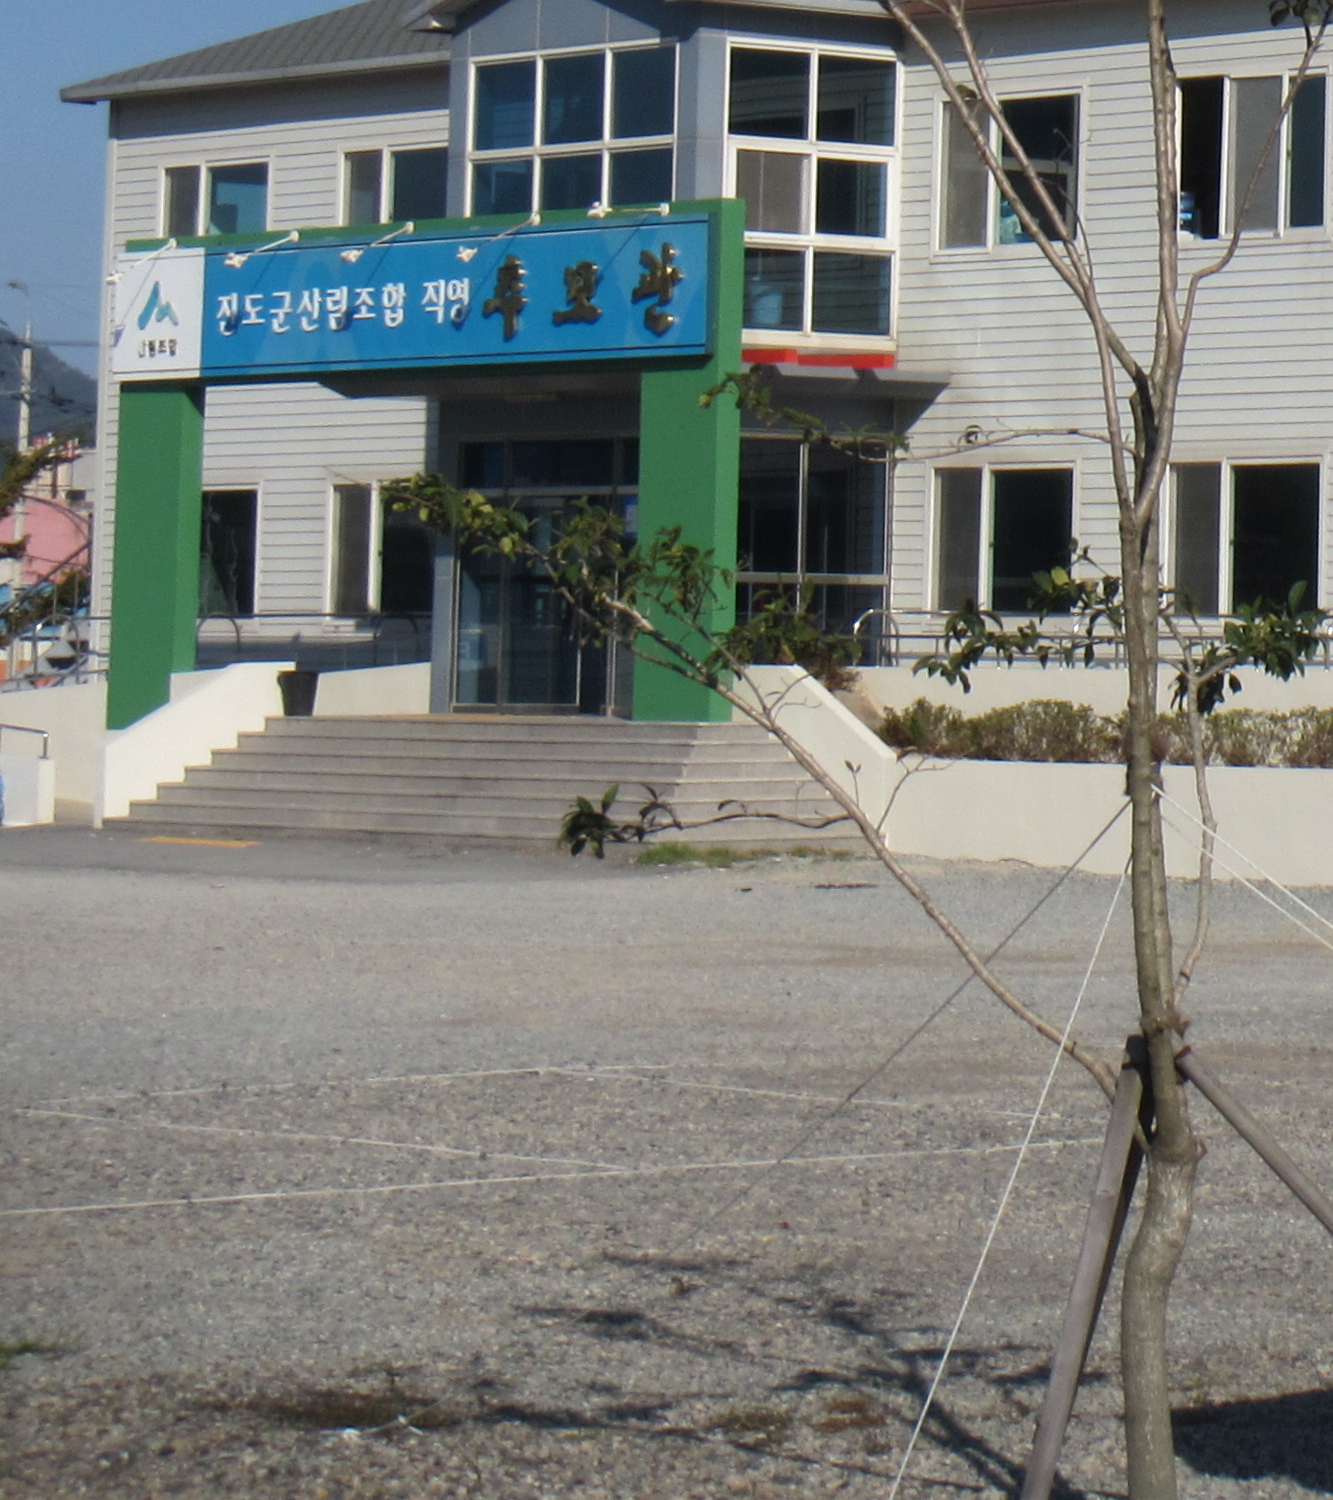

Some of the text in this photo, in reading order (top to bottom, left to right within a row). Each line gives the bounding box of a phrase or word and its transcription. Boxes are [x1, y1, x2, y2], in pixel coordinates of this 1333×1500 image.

[216, 242, 683, 342] 진도군산림조합 직영 추모관
